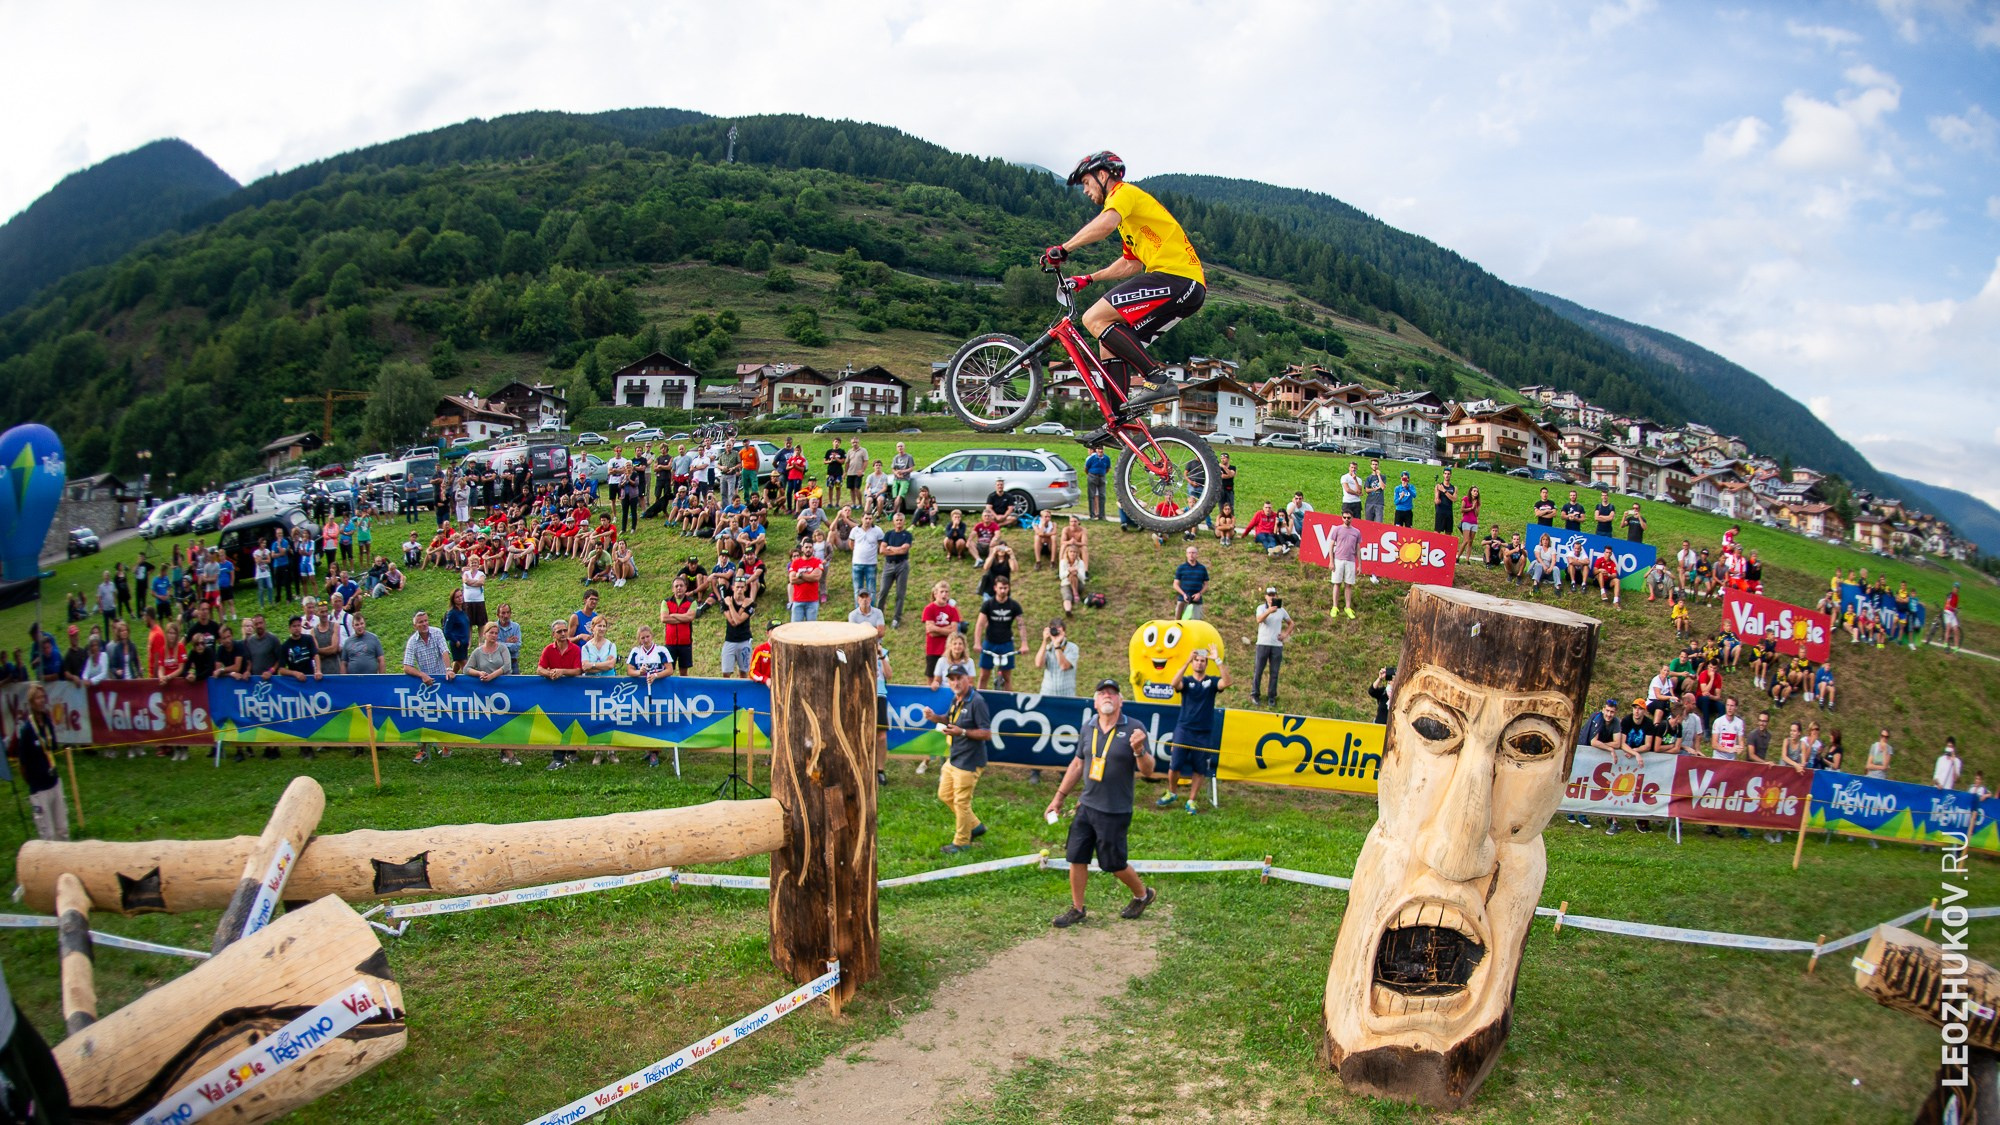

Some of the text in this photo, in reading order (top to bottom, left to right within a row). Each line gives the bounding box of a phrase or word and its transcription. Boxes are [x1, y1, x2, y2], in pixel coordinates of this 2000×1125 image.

[1111, 287, 1170, 306] hebo
[234, 688, 714, 726] TRENTINO TRENTINO TRENTINO
[1255, 732, 1380, 779] Melin
[1831, 783, 1896, 817] TRENTINO
[265, 1016, 334, 1064] TRENTINO
[644, 1058, 684, 1084] TRENTINO
[734, 1014, 768, 1038] TRENTINO
